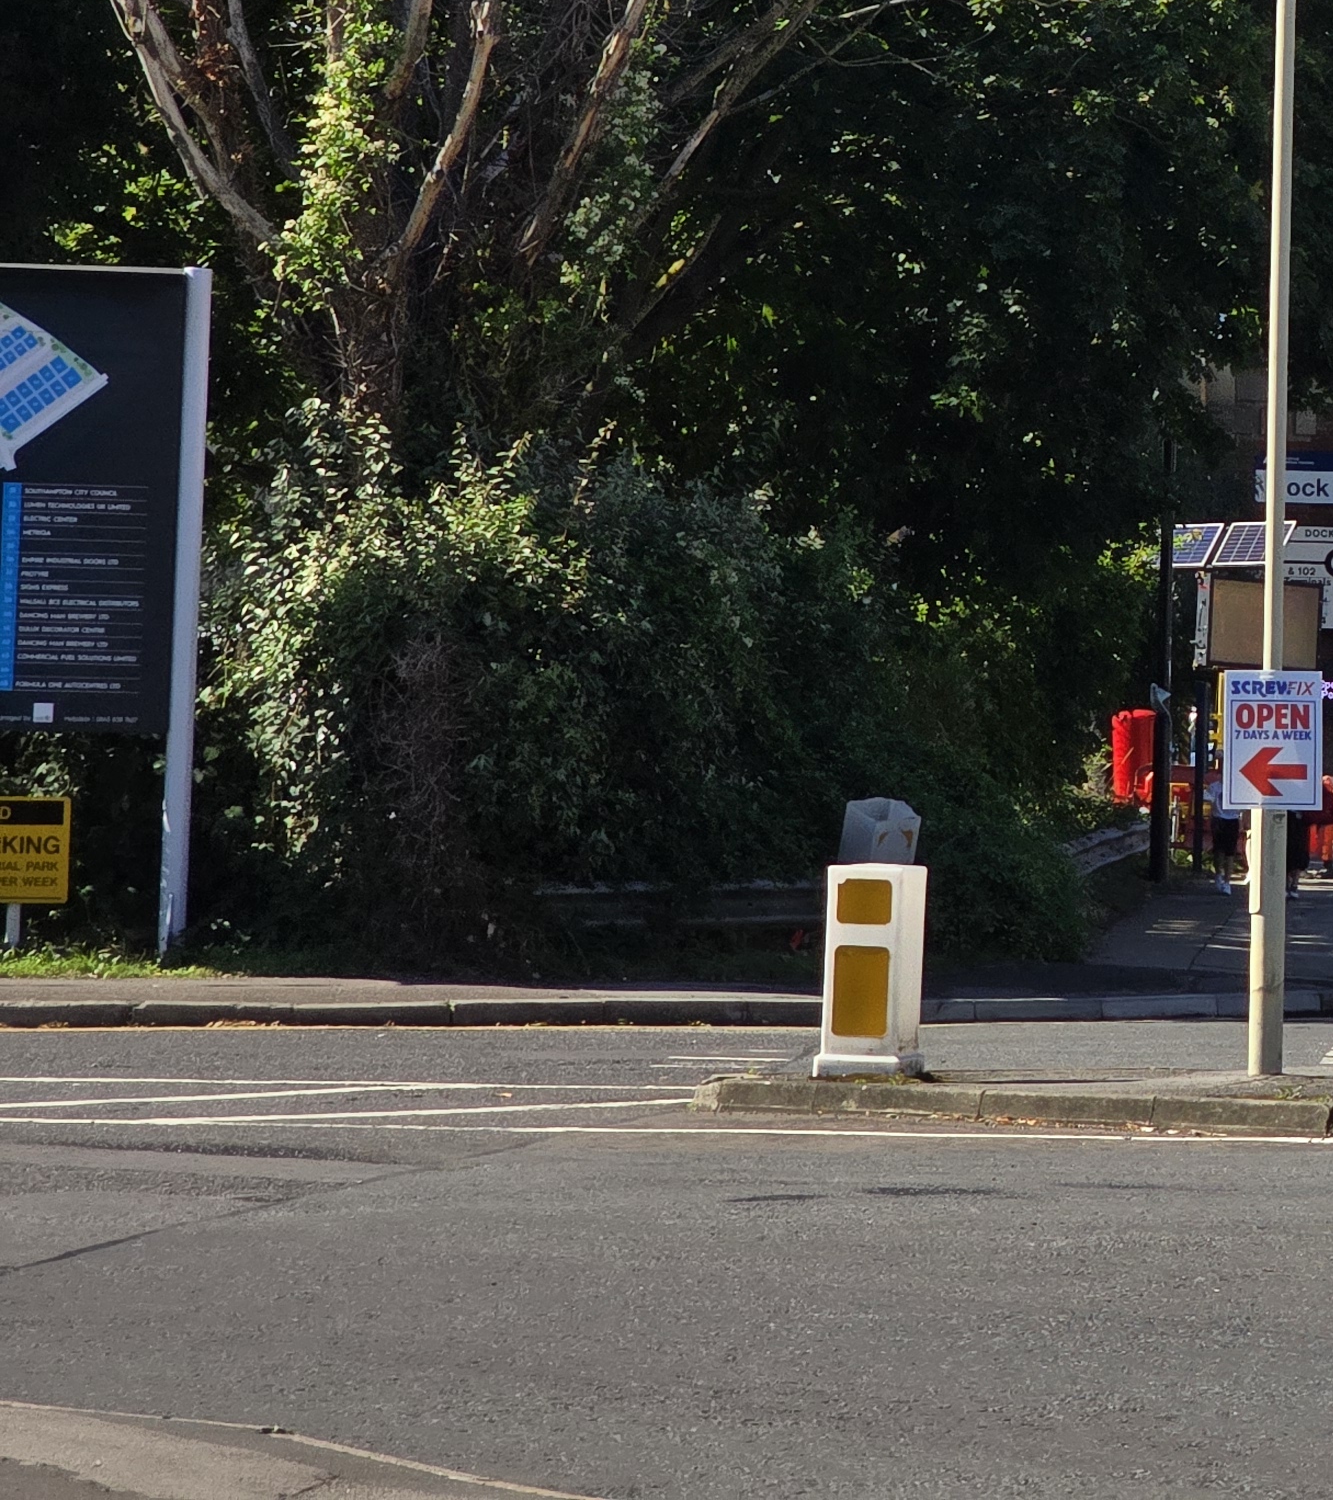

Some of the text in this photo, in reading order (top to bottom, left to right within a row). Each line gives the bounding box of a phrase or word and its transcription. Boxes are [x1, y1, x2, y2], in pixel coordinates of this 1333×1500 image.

[1286, 478, 1329, 497] ock
[1288, 567, 1316, 576] & 102
[1231, 681, 1315, 697] SCREWFIX
[1235, 704, 1310, 730] OPEN
[1235, 730, 1312, 740] 7 DAYS A WEEK
[0, 836, 60, 855] KING
[26, 861, 59, 872] PARK
[0, 876, 58, 886] ER WEEK
